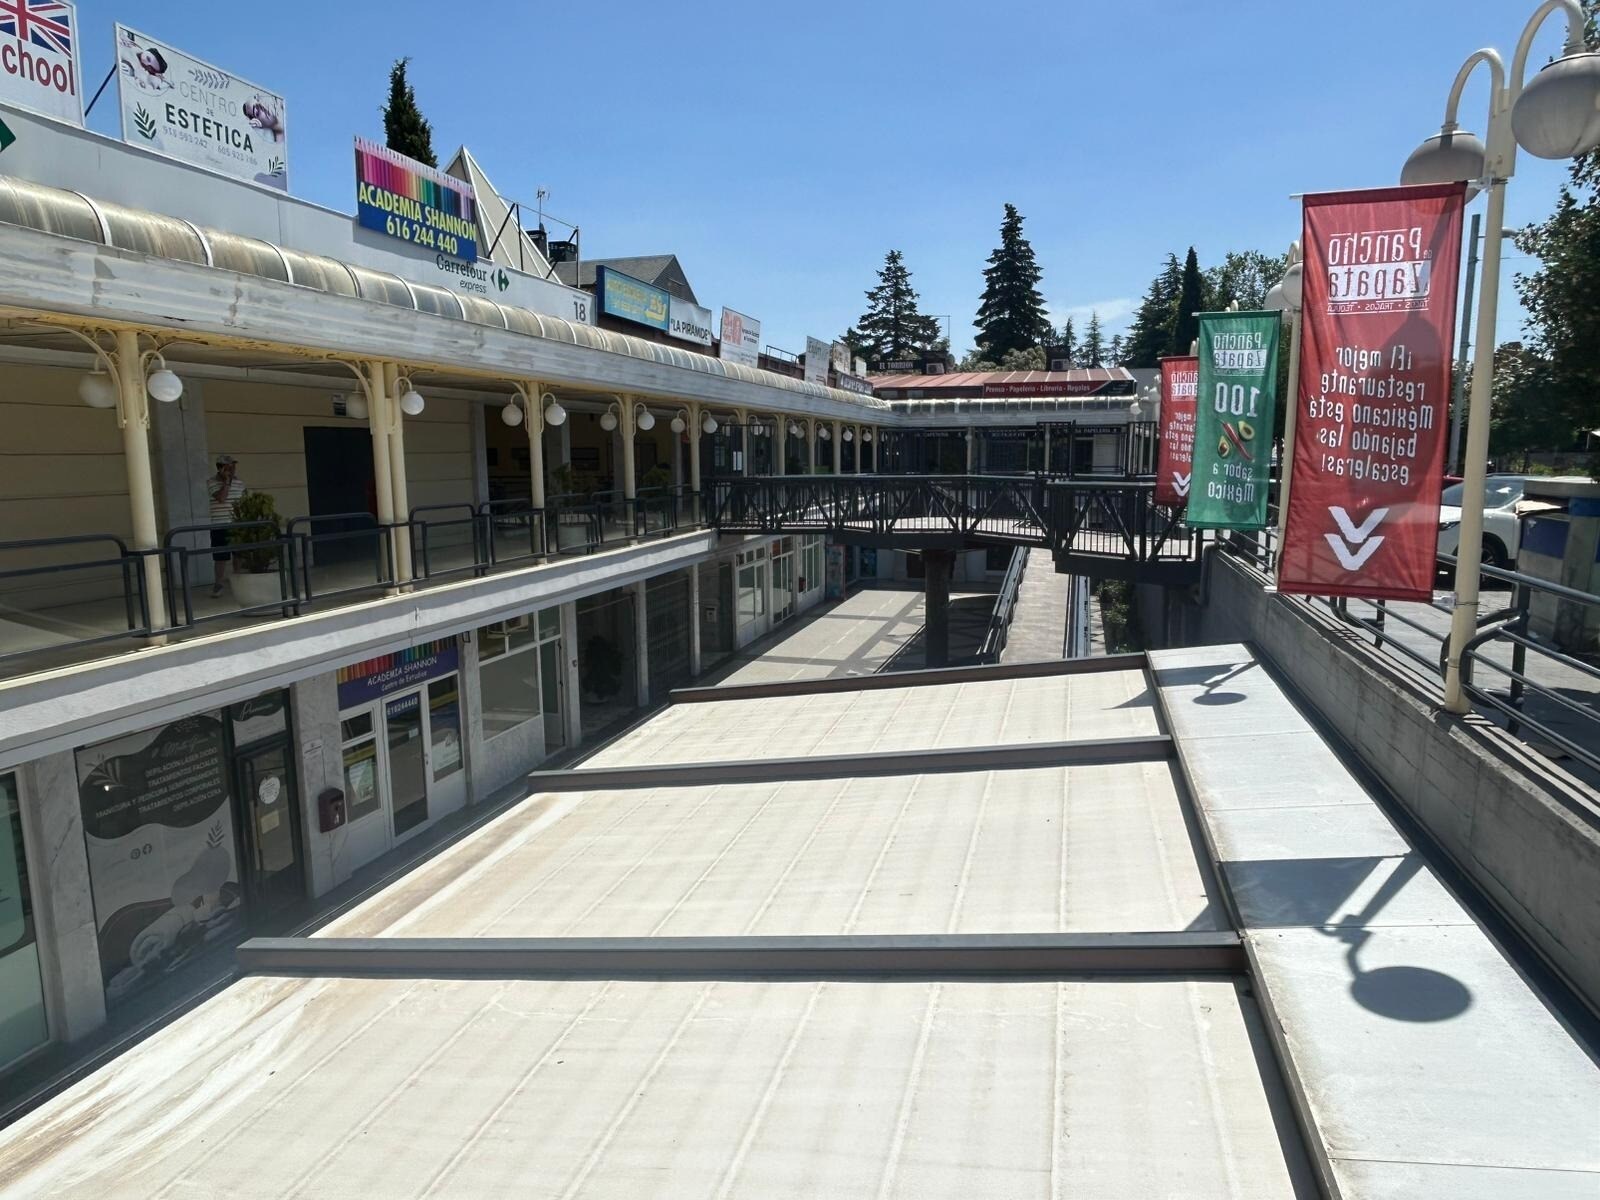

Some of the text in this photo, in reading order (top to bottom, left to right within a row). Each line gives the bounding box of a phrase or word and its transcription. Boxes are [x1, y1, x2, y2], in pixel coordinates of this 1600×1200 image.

[1, 39, 76, 97] chool
[179, 81, 237, 117] CENTRO
[165, 102, 254, 153] ESTETICA
[359, 181, 477, 242] ACADEMIA SHANNON
[386, 215, 458, 255] 616 244 440
[436, 253, 488, 282] Carrefour
[460, 280, 487, 294] express
[573, 300, 586, 321] 18
[985, 385, 1005, 393] Prensa
[367, 656, 437, 687] ACADEMIA SHANNON
